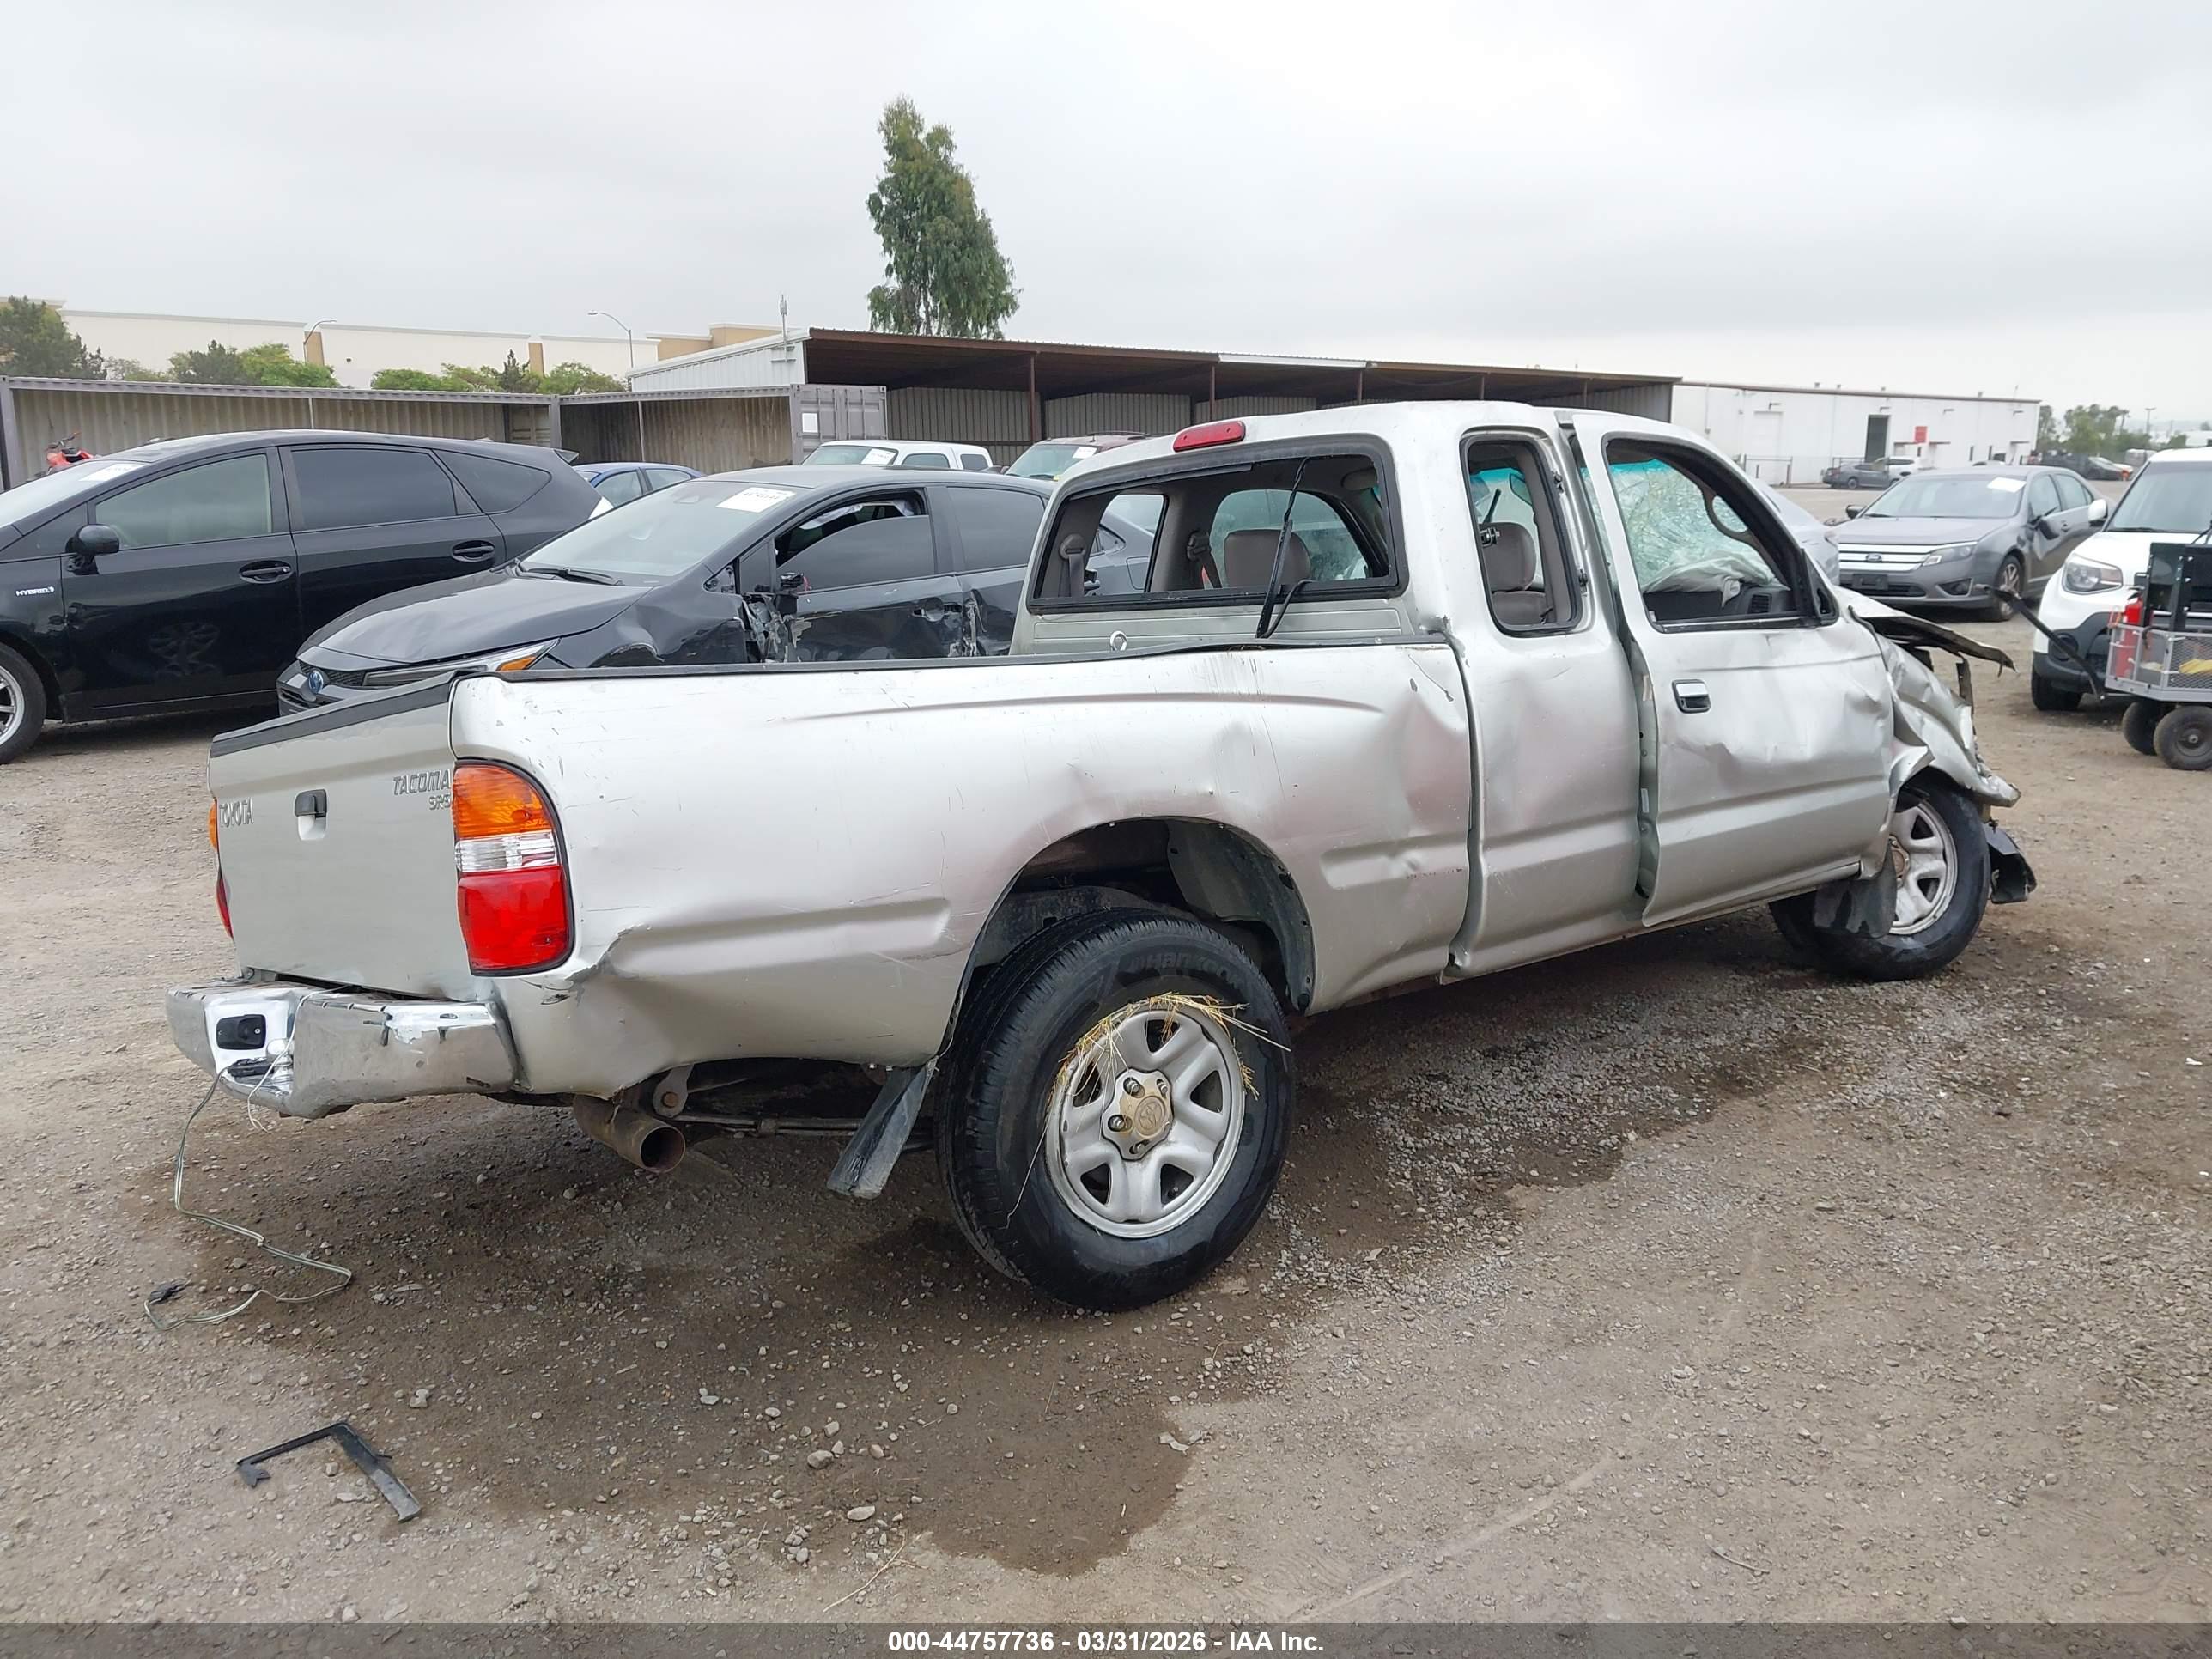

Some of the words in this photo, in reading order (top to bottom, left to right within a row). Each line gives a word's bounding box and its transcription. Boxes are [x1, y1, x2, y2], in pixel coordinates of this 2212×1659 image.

[15, 587, 50, 597] HYBRID
[393, 769, 451, 795] TACOMA
[219, 797, 254, 828] TOYOTA
